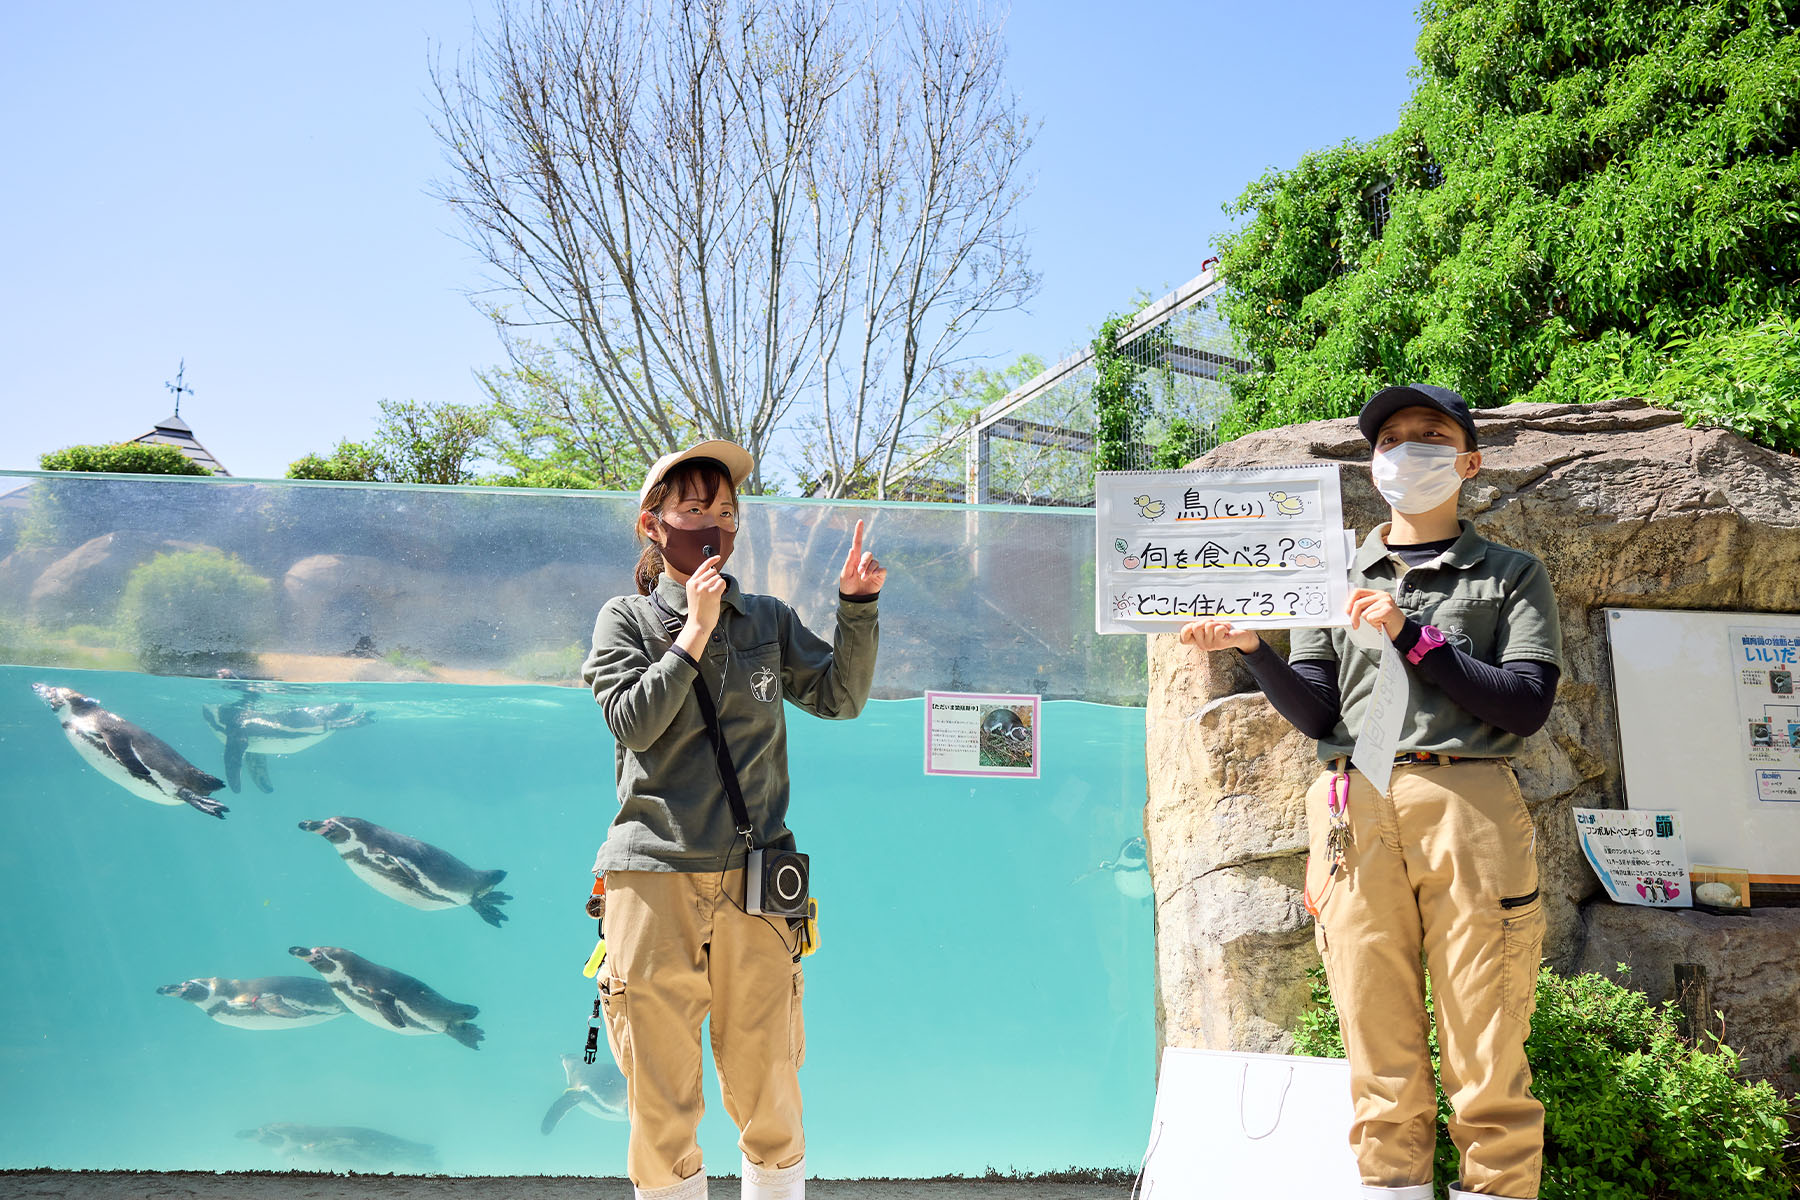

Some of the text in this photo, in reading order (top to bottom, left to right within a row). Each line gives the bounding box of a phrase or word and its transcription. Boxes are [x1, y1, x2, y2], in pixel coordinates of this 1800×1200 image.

[1178, 488, 1264, 520] 鳥（とり）
[1140, 537, 1295, 569] 何を食べる？
[1137, 591, 1300, 617] どこに住んでる？
[1745, 647, 1797, 664] いいだ
